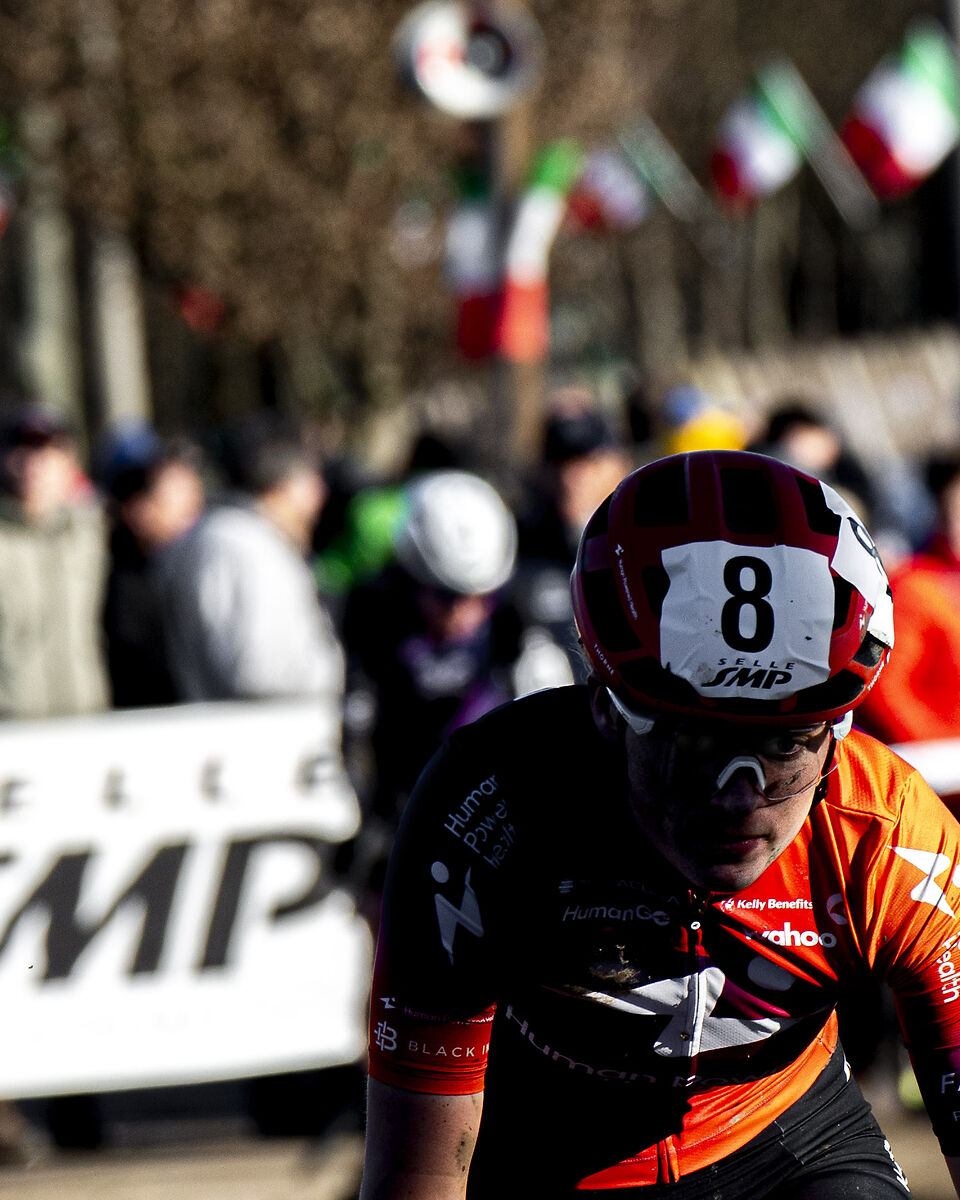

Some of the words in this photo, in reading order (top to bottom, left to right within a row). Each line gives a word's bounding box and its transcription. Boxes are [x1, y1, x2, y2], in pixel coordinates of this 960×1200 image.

[721, 555, 775, 653] 8
[717, 657, 796, 670] SELLE
[701, 667, 793, 689] SMP
[0, 830, 348, 984] MP
[737, 899, 767, 911] Kelly
[767, 898, 813, 910] Benefits
[745, 921, 837, 948] ahoo
[408, 1040, 476, 1057] BLACK
